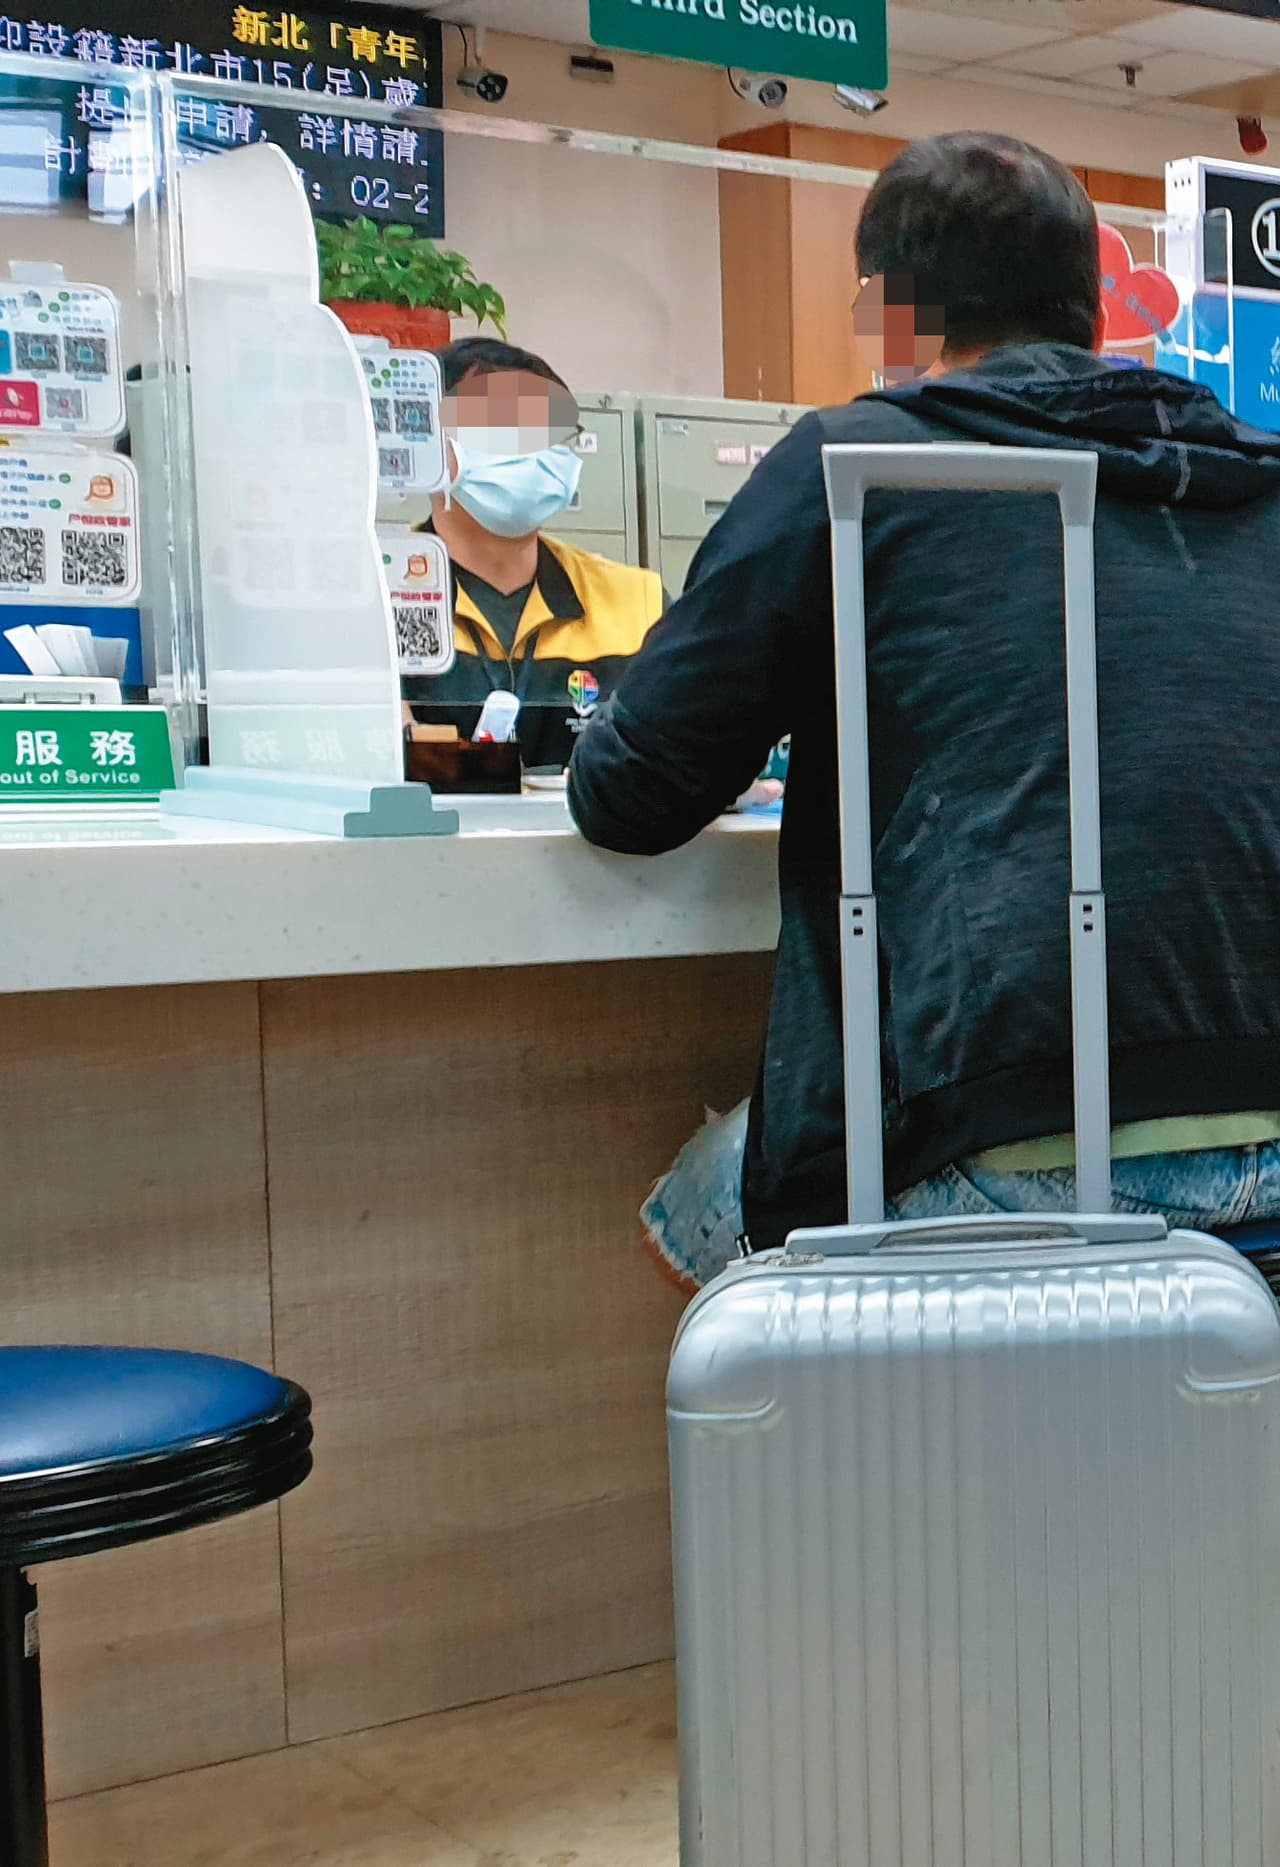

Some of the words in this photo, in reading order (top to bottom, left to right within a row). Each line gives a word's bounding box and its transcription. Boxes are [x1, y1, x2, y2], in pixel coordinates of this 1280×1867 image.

[739, 0, 858, 44] Section
[16, 729, 136, 766] 服務
[0, 771, 33, 784] out
[39, 769, 59, 784] of
[65, 769, 140, 785] Service
